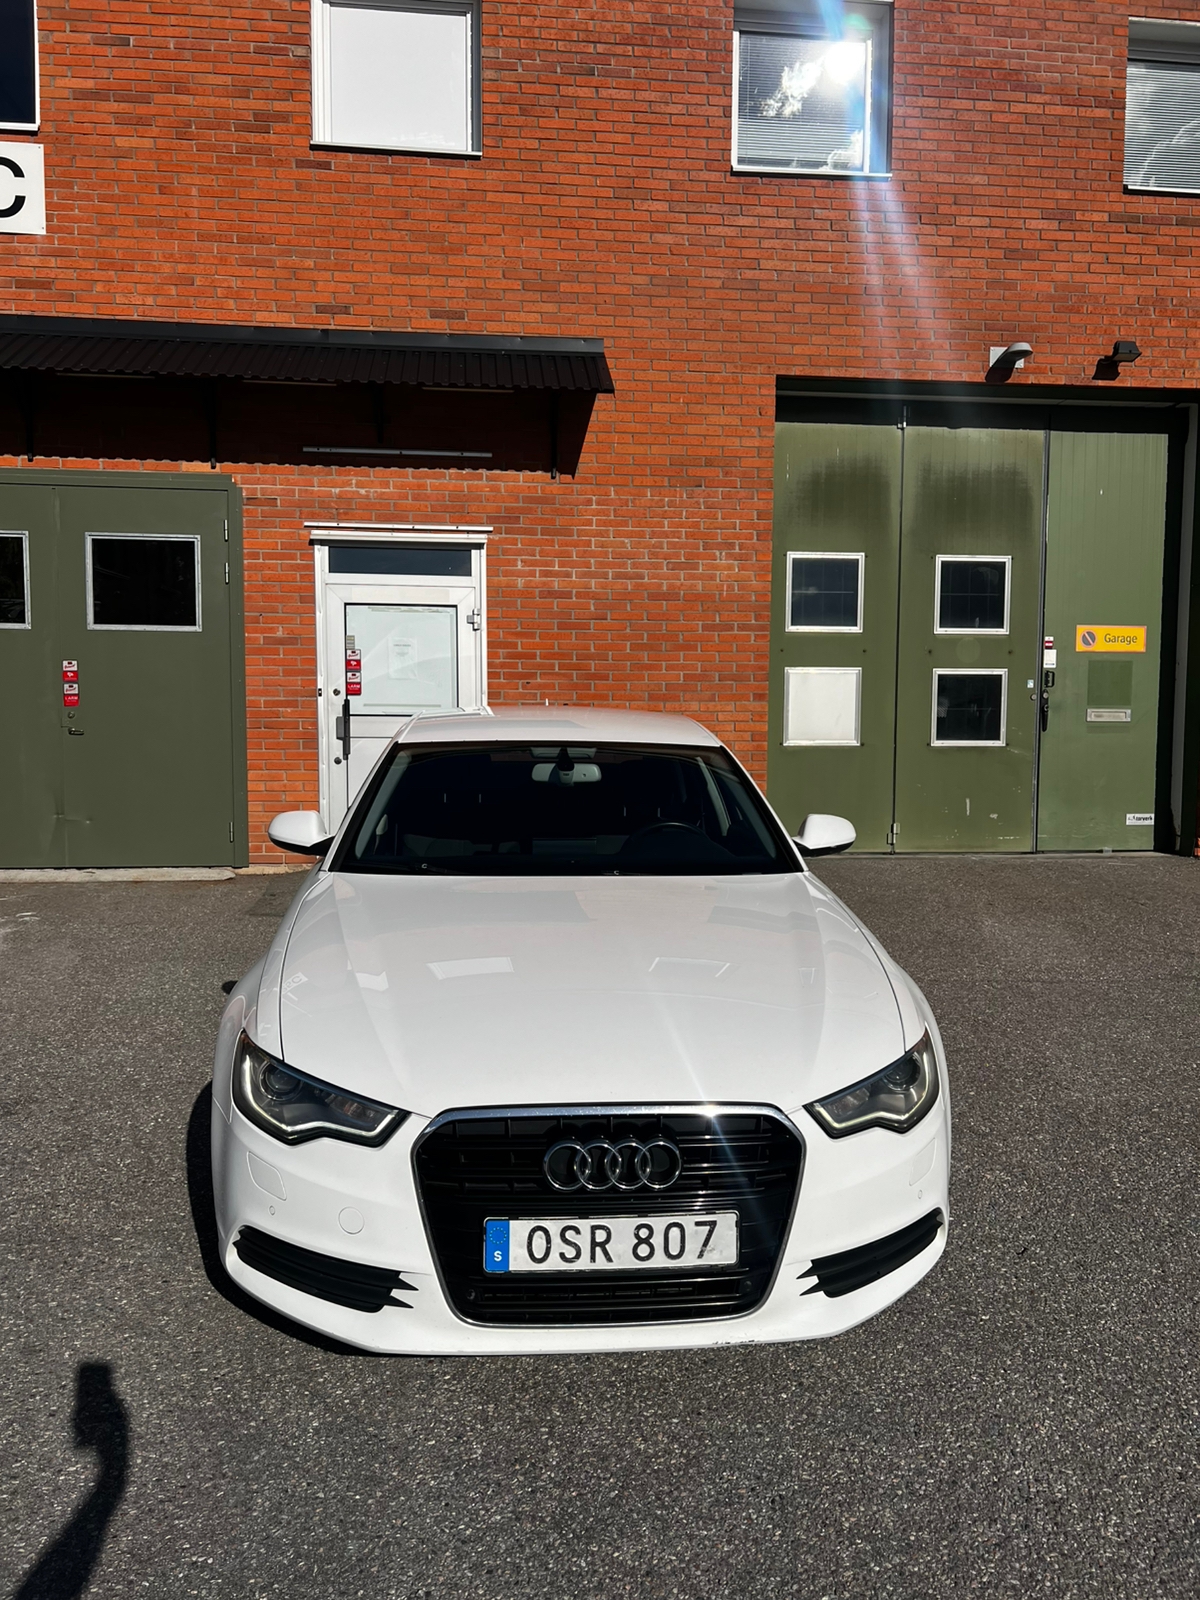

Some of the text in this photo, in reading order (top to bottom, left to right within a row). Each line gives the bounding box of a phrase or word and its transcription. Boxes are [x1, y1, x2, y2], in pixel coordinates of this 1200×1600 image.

[1104, 633, 1138, 645] Garage
[526, 1220, 718, 1265] OSR 807
[493, 1250, 503, 1262] S
